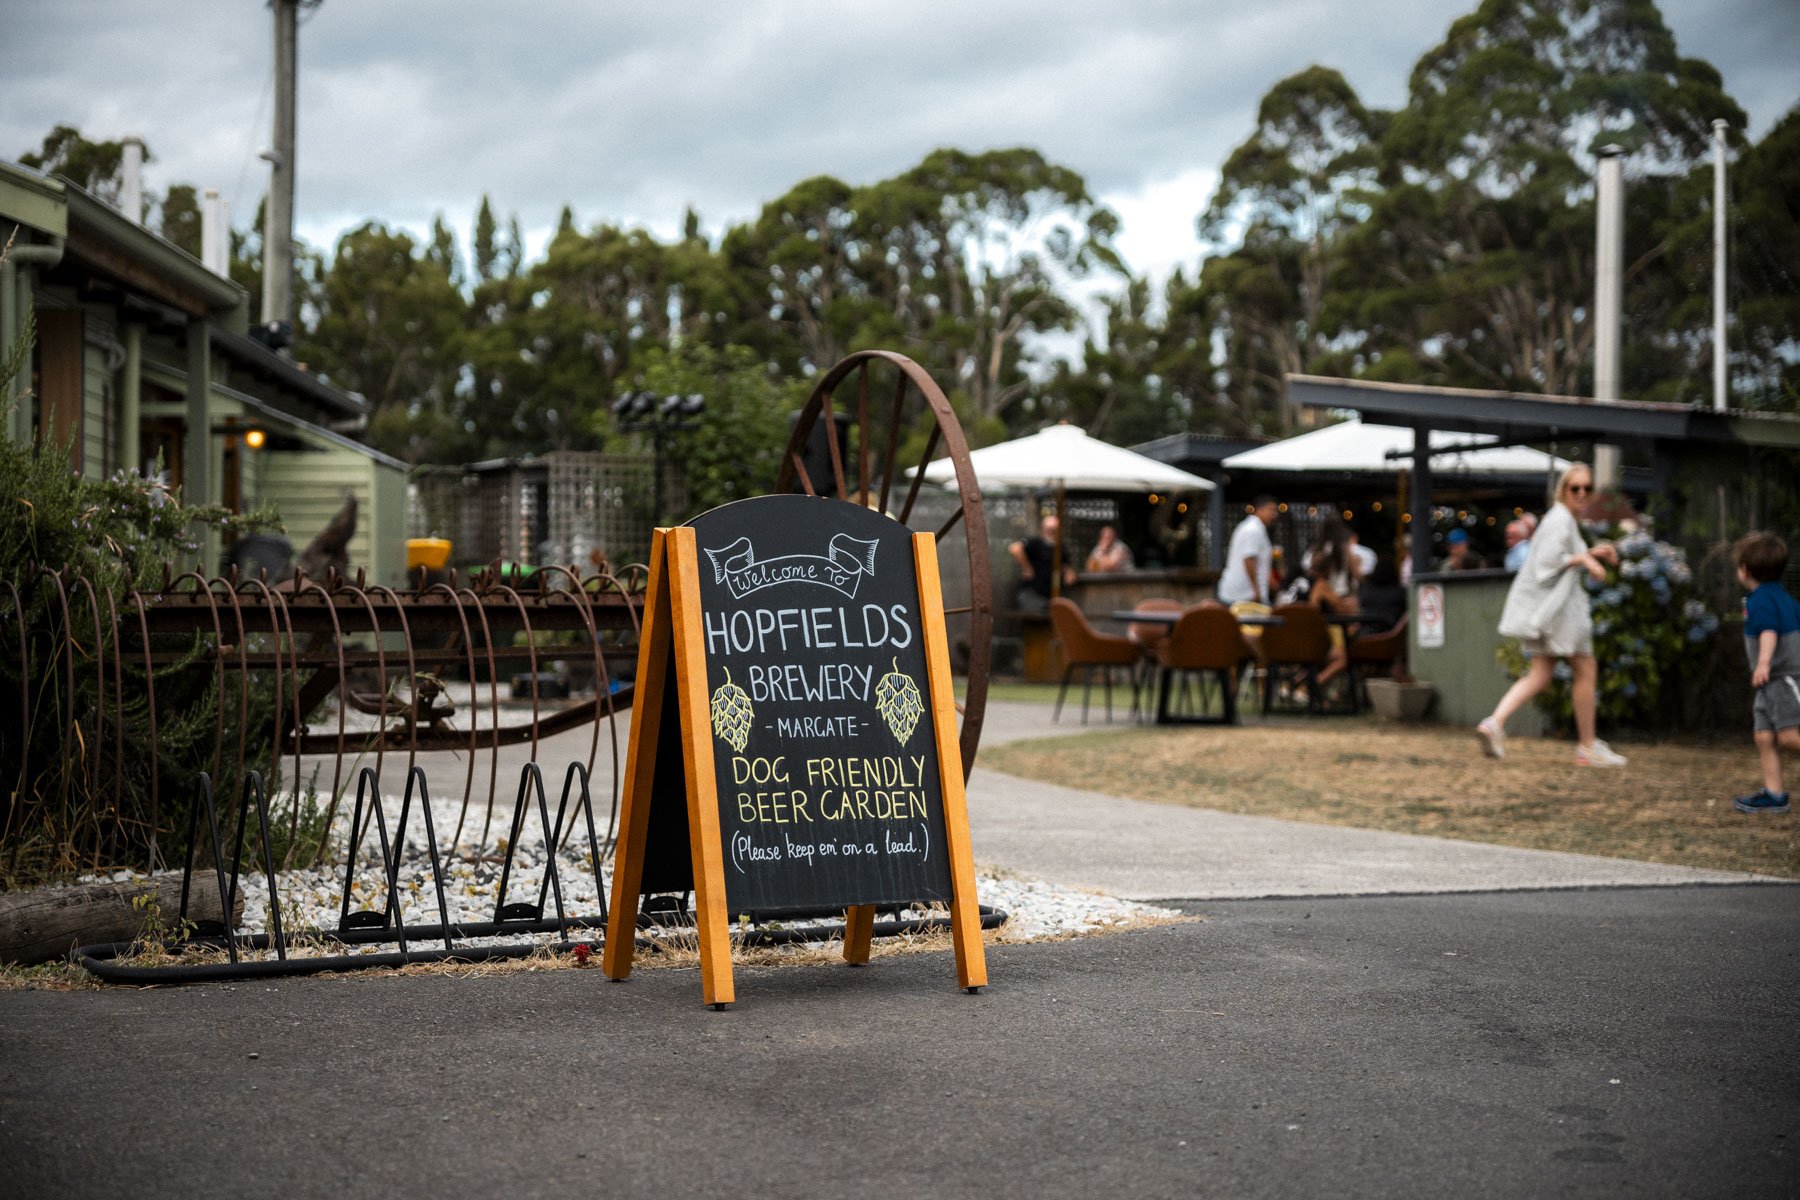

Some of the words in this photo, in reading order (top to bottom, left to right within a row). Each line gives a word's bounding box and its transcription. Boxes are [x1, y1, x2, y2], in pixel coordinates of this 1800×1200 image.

[733, 564, 818, 591] Welcome
[824, 566, 851, 586] To
[705, 603, 913, 656] HOPFIELDS
[749, 663, 873, 702] BREWERY
[732, 756, 790, 784] DOG
[806, 755, 925, 787] FRIENDLY
[737, 790, 814, 823] BEER
[820, 789, 928, 820] GARDEN
[731, 829, 782, 874] (Please
[785, 832, 815, 867] keep
[843, 842, 863, 856] on
[865, 842, 878, 855] a
